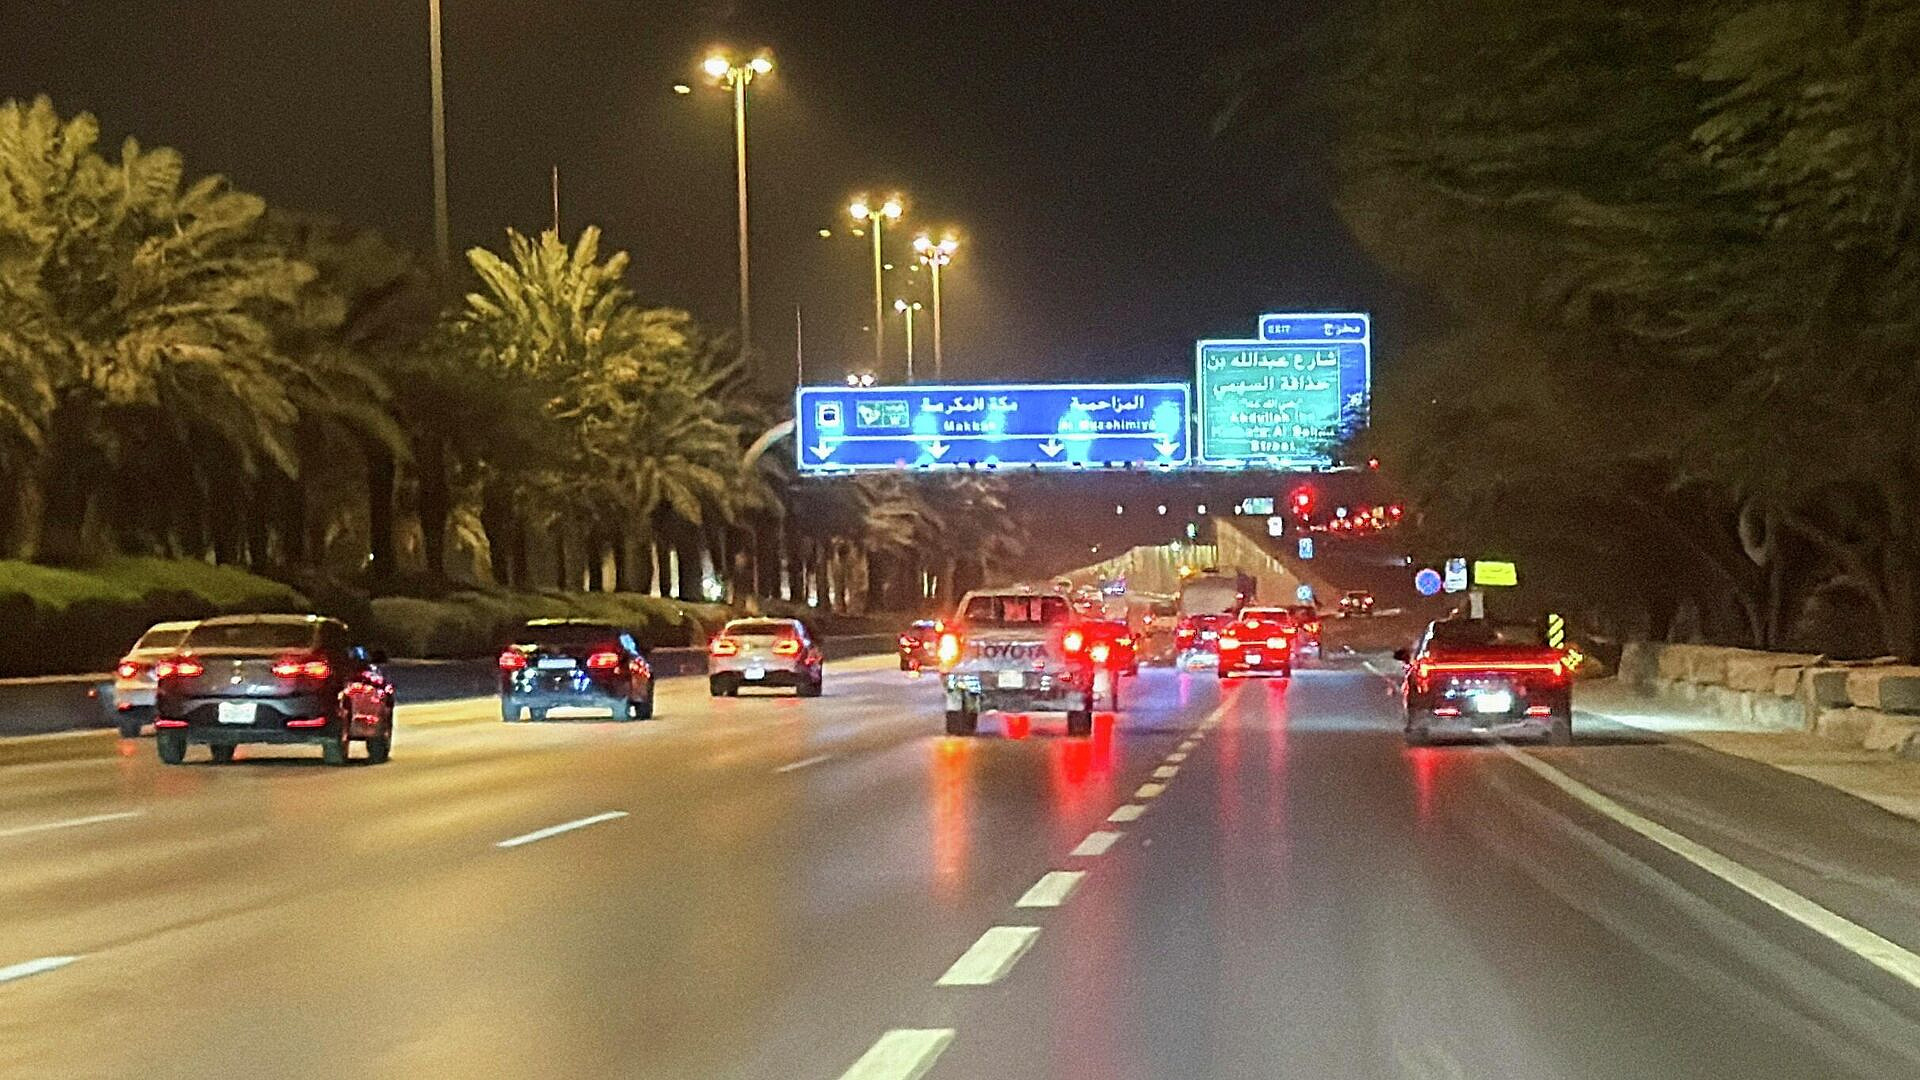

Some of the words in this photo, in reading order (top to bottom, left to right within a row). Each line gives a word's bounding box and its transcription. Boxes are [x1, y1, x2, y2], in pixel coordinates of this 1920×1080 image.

[1206, 354, 1226, 371] بن
[1230, 351, 1290, 371] عبدالله
[1293, 351, 1337, 371] شارع
[943, 420, 997, 432] Makka
[973, 645, 1049, 659] TOYOTA
